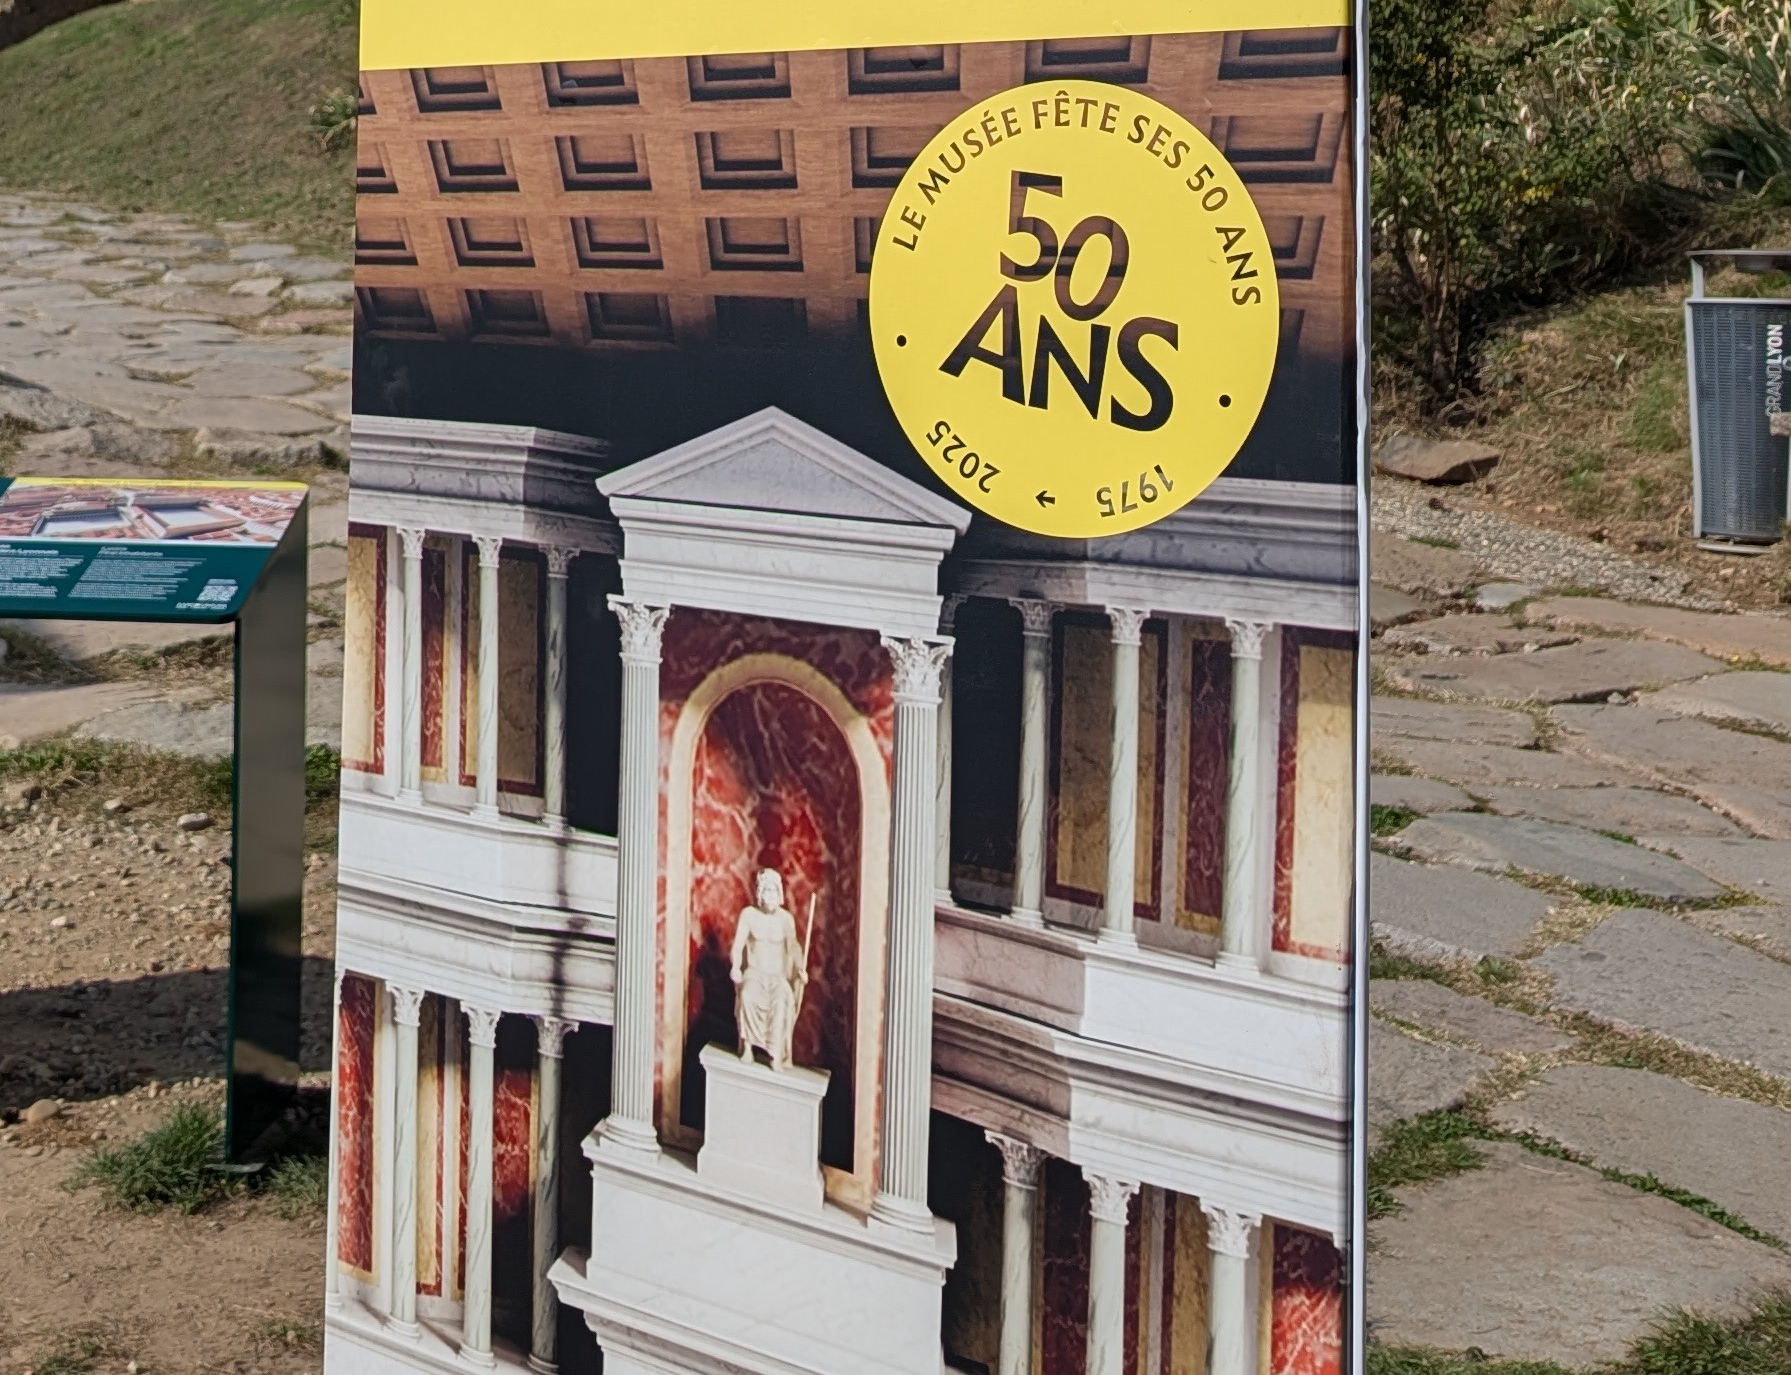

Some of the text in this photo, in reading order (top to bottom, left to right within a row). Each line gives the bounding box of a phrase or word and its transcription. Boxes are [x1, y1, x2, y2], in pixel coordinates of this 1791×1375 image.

[892, 90, 1261, 306] LE MUSÉE FÊTE SES 50 ANS
[999, 169, 1130, 322] 50
[938, 283, 1179, 432] ANS
[925, 420, 1174, 518] 1975 2025
